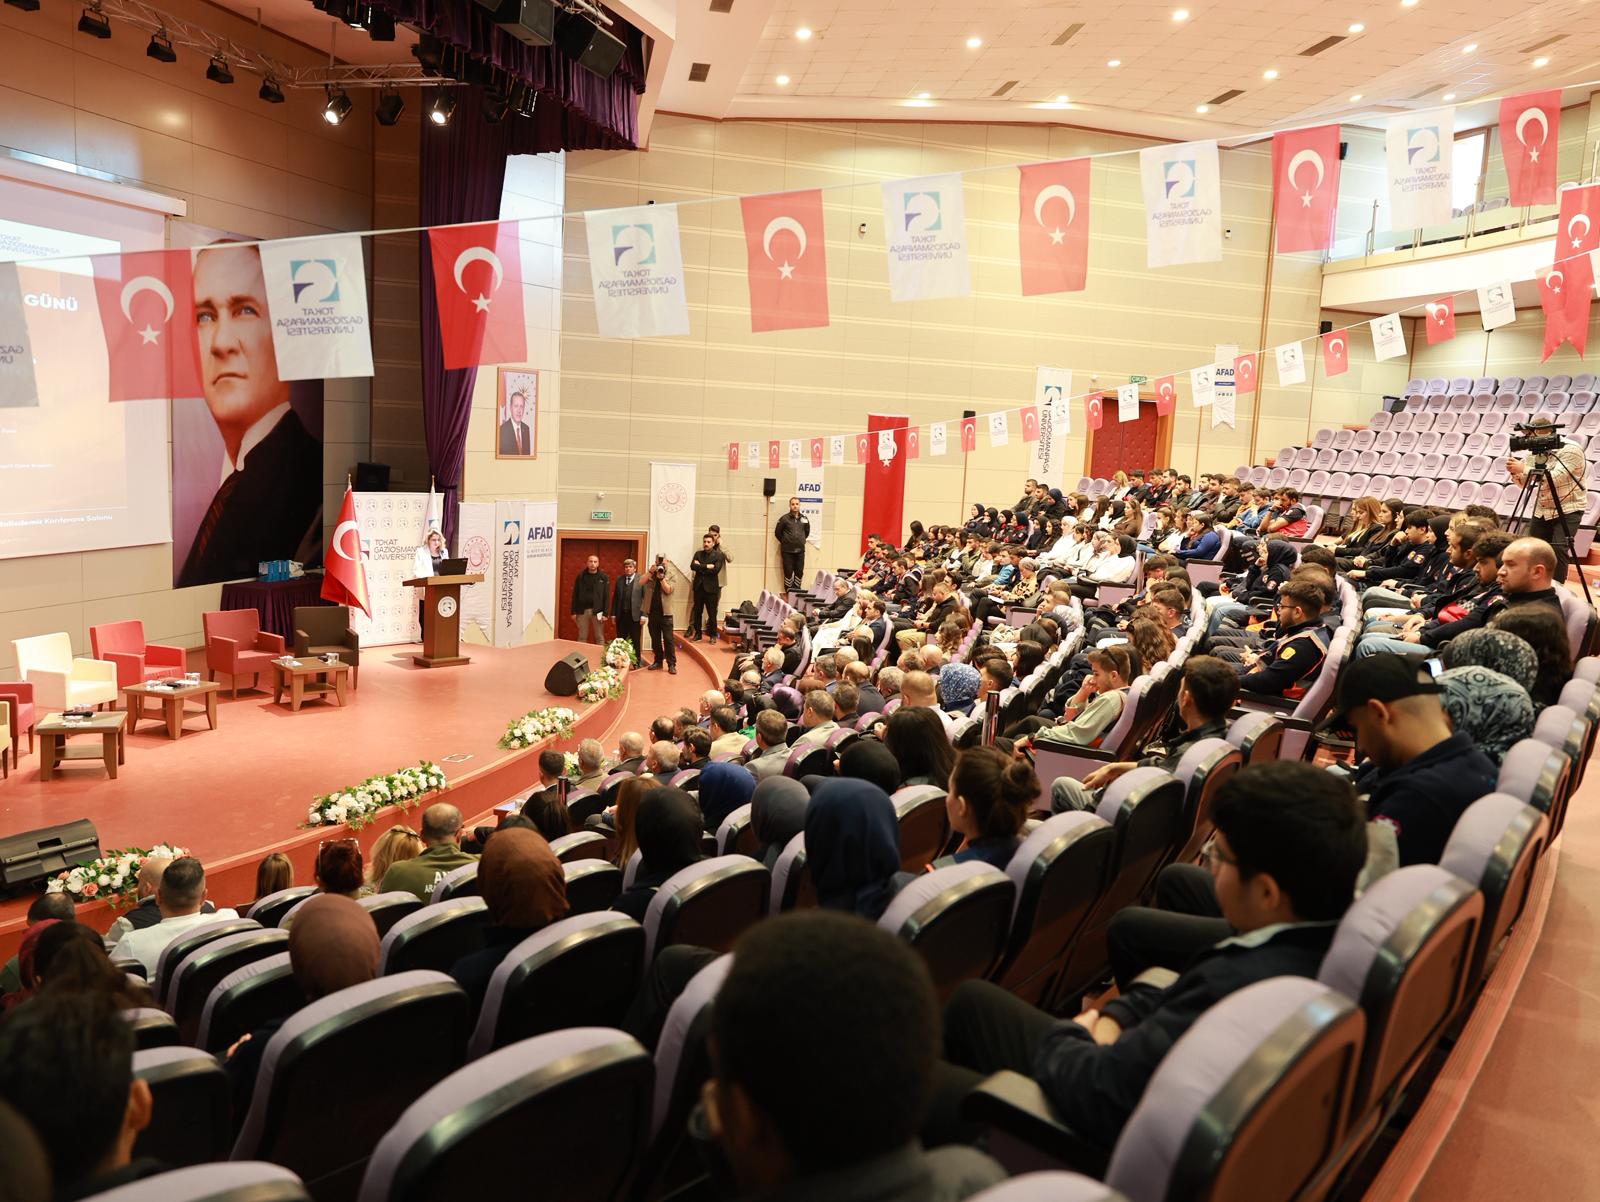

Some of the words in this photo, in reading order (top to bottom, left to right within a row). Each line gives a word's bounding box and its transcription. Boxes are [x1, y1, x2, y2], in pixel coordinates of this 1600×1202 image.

[24, 292, 78, 312] GÜNÜ
[1215, 368, 1235, 376] AFAD
[798, 483, 821, 492] AFAD
[527, 526, 553, 540] AFAD
